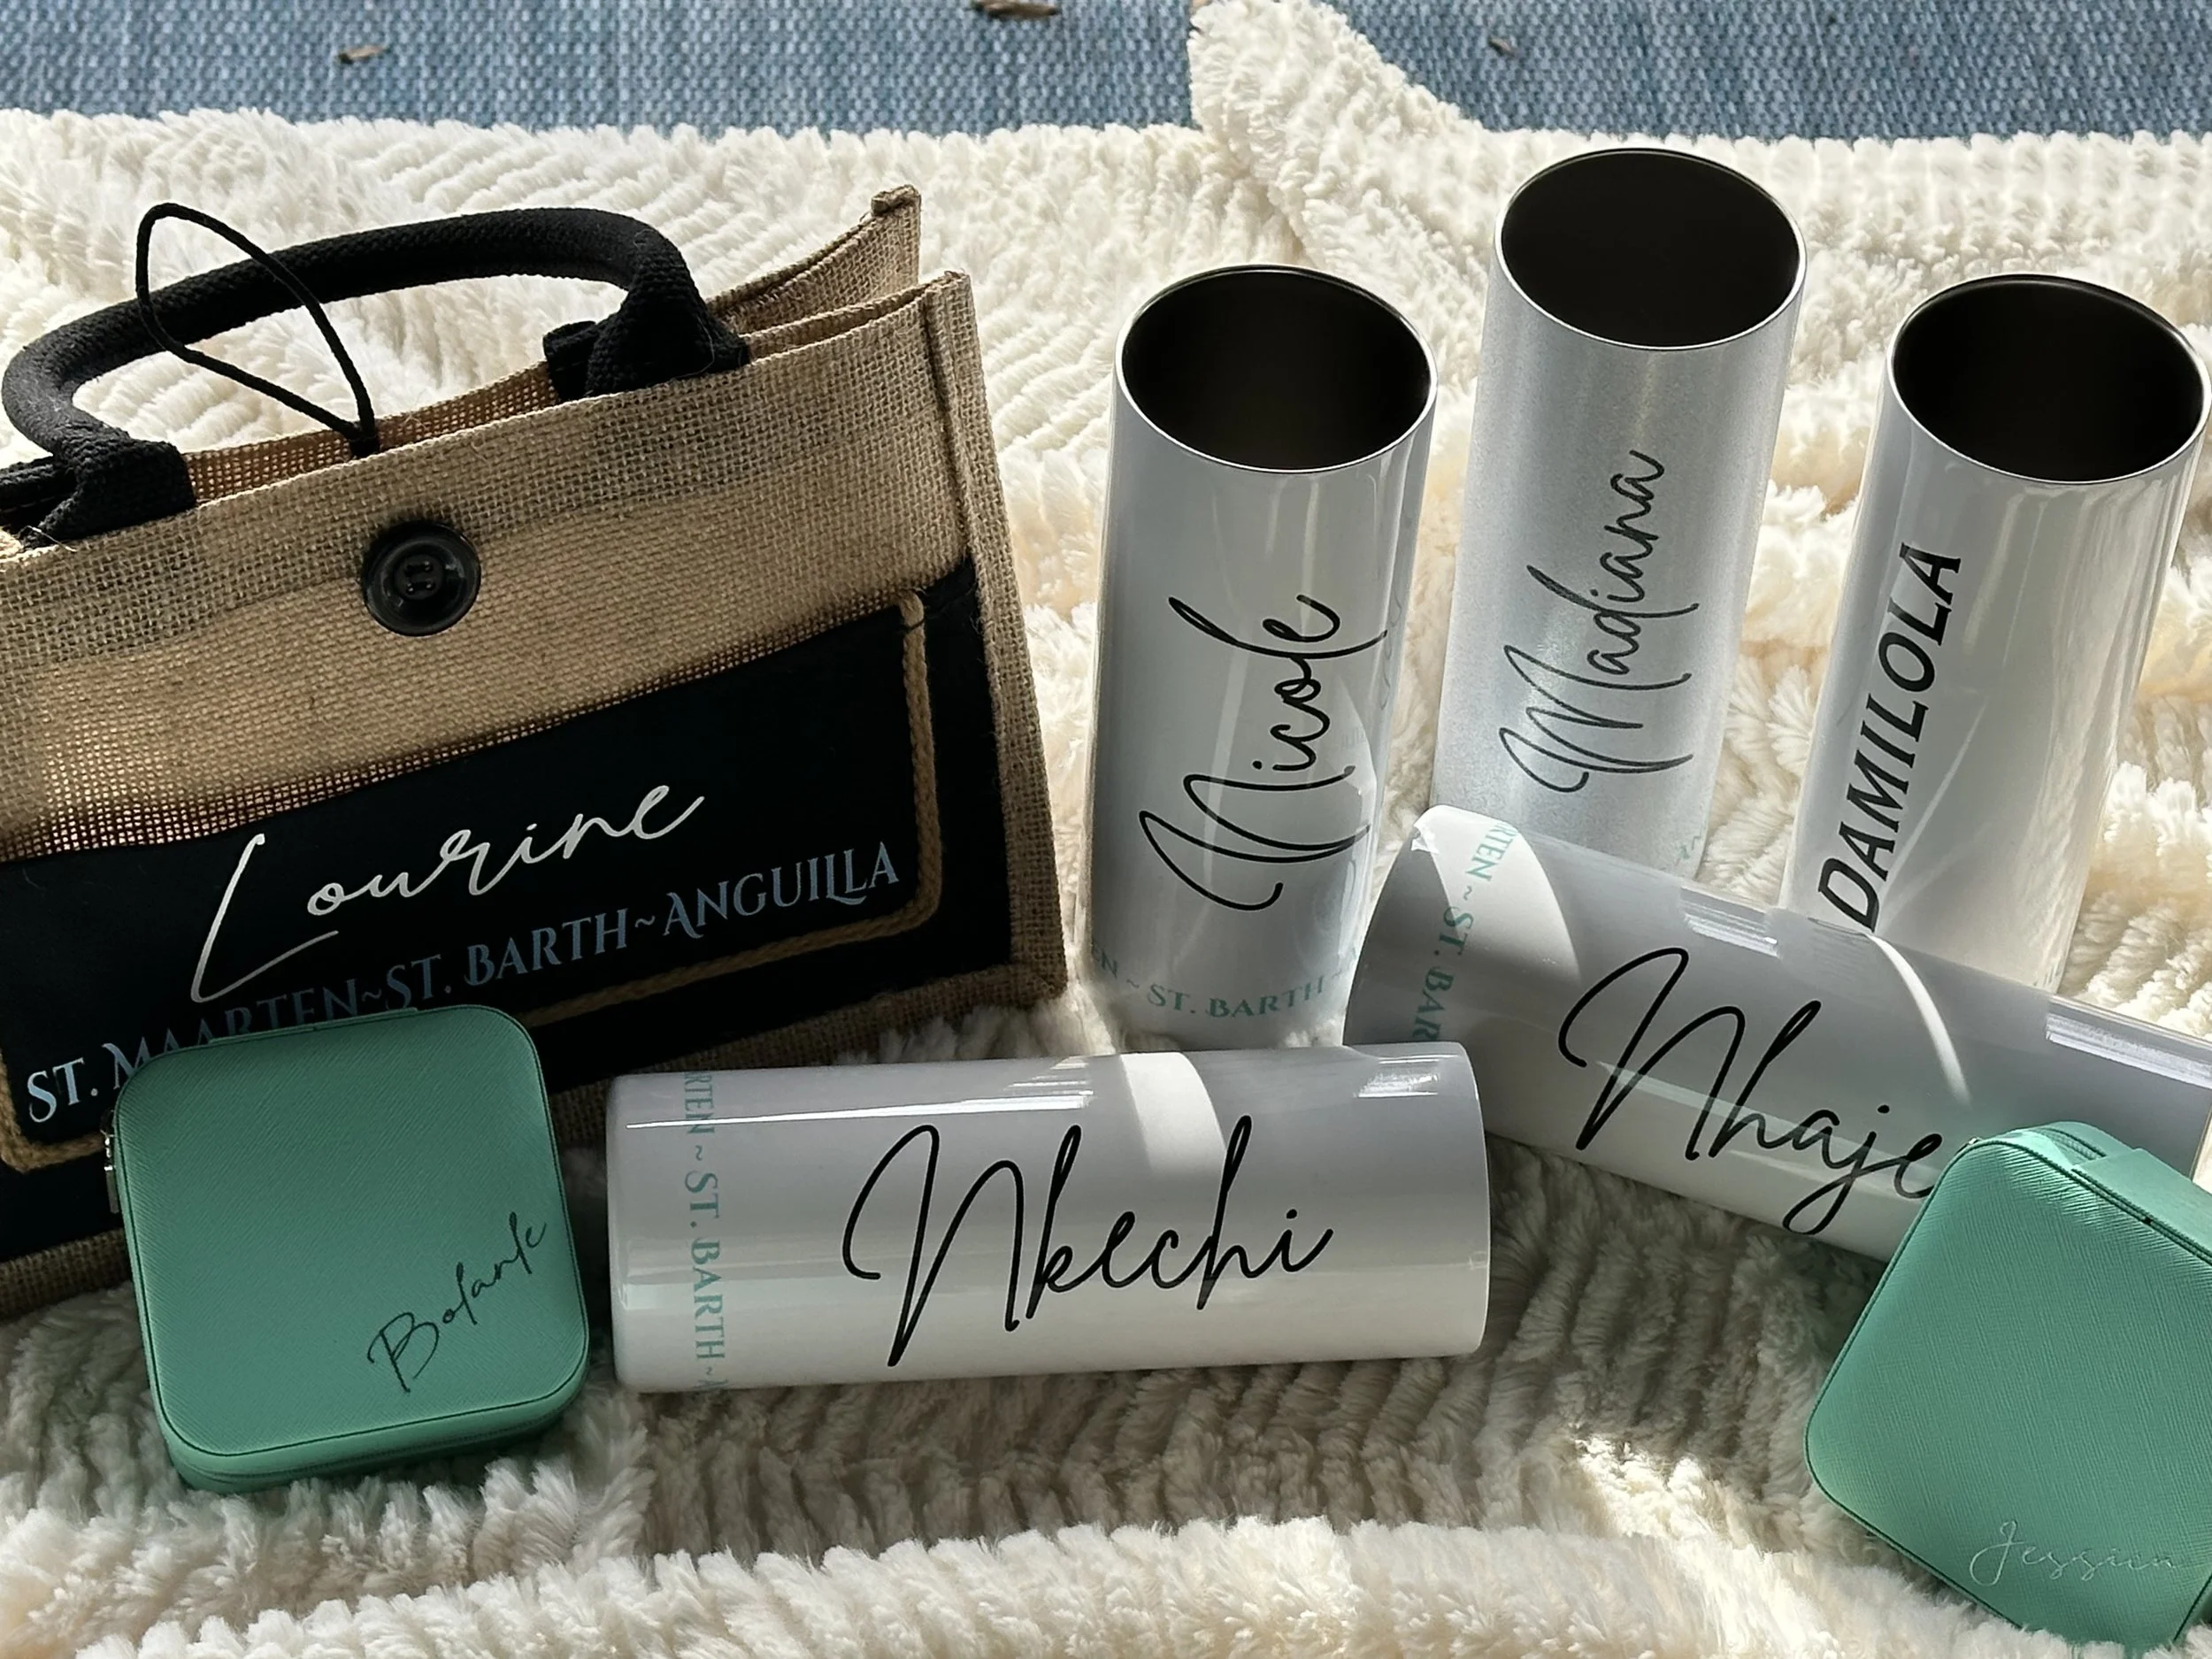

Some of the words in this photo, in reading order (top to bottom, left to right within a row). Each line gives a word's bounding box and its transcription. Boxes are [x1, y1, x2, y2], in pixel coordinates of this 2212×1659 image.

[1499, 449, 1699, 793] Madiana
[1140, 594, 1387, 910] Nicole
[1818, 541, 1961, 933] DAMILOLA
[1464, 822, 1519, 882] RTEN
[190, 785, 704, 1002] Lourine
[1432, 906, 1474, 956] ST.
[1147, 984, 1196, 1014] ST.
[1205, 975, 1324, 1018] BARTH
[1412, 966, 1454, 1041] BAR
[27, 1057, 98, 1124] ST.
[684, 1071, 715, 1133] RTEN
[685, 1170, 720, 1228] ST.
[842, 1115, 1333, 1367] Nkechi
[691, 1239, 726, 1359] BARTH
